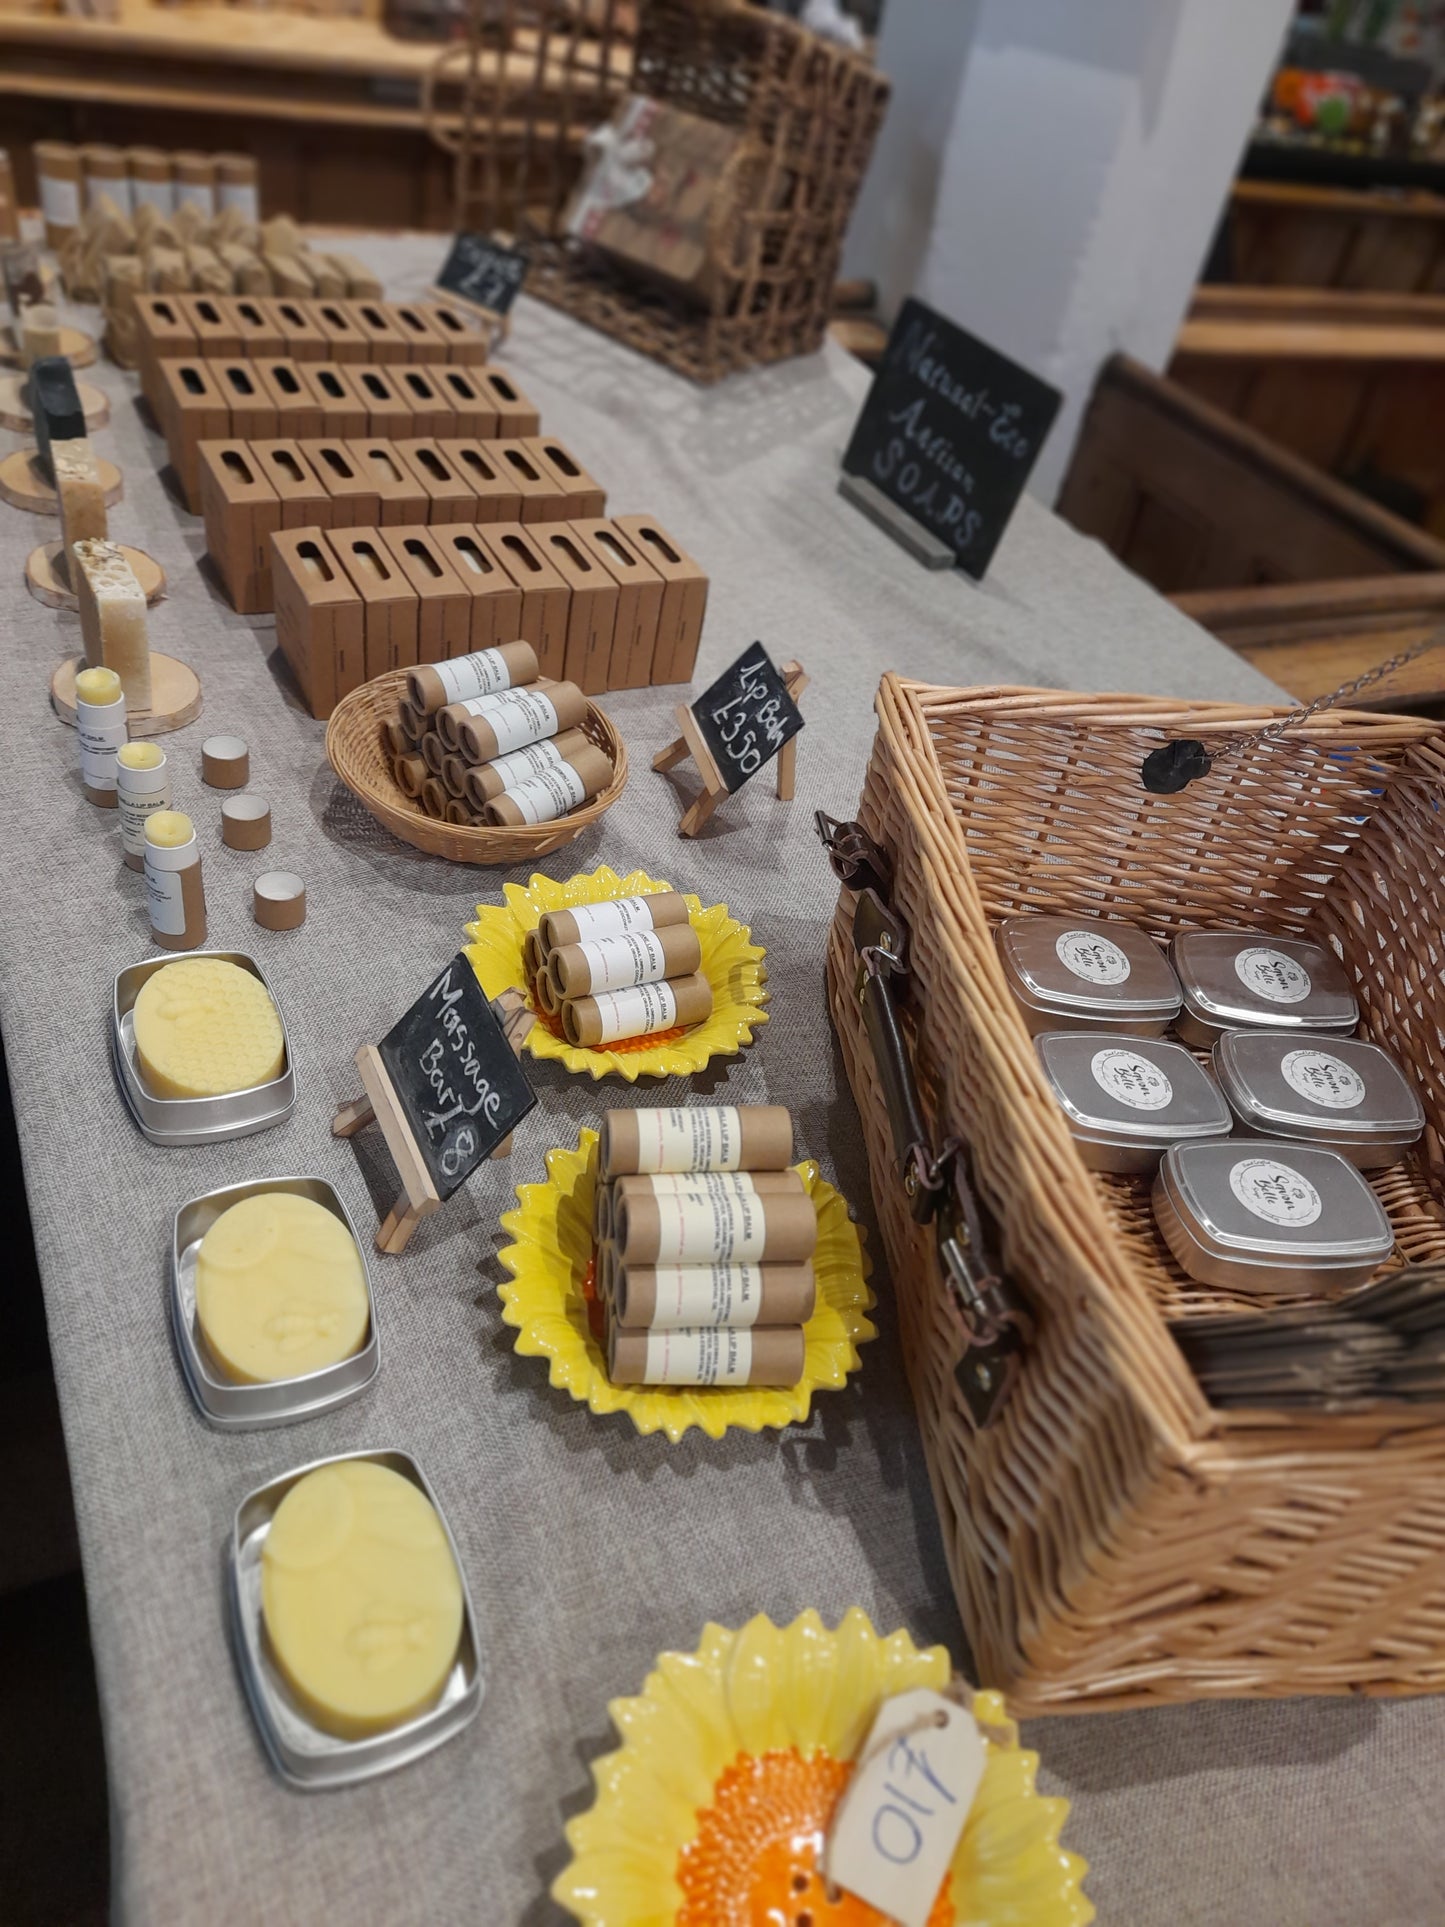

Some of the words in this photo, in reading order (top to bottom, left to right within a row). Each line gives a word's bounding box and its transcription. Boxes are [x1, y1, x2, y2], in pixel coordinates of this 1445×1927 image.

[419, 1038, 455, 1106] Bar
[429, 967, 501, 1130] Massage
[421, 1103, 476, 1176] £8
[872, 1735, 957, 1865] £10
